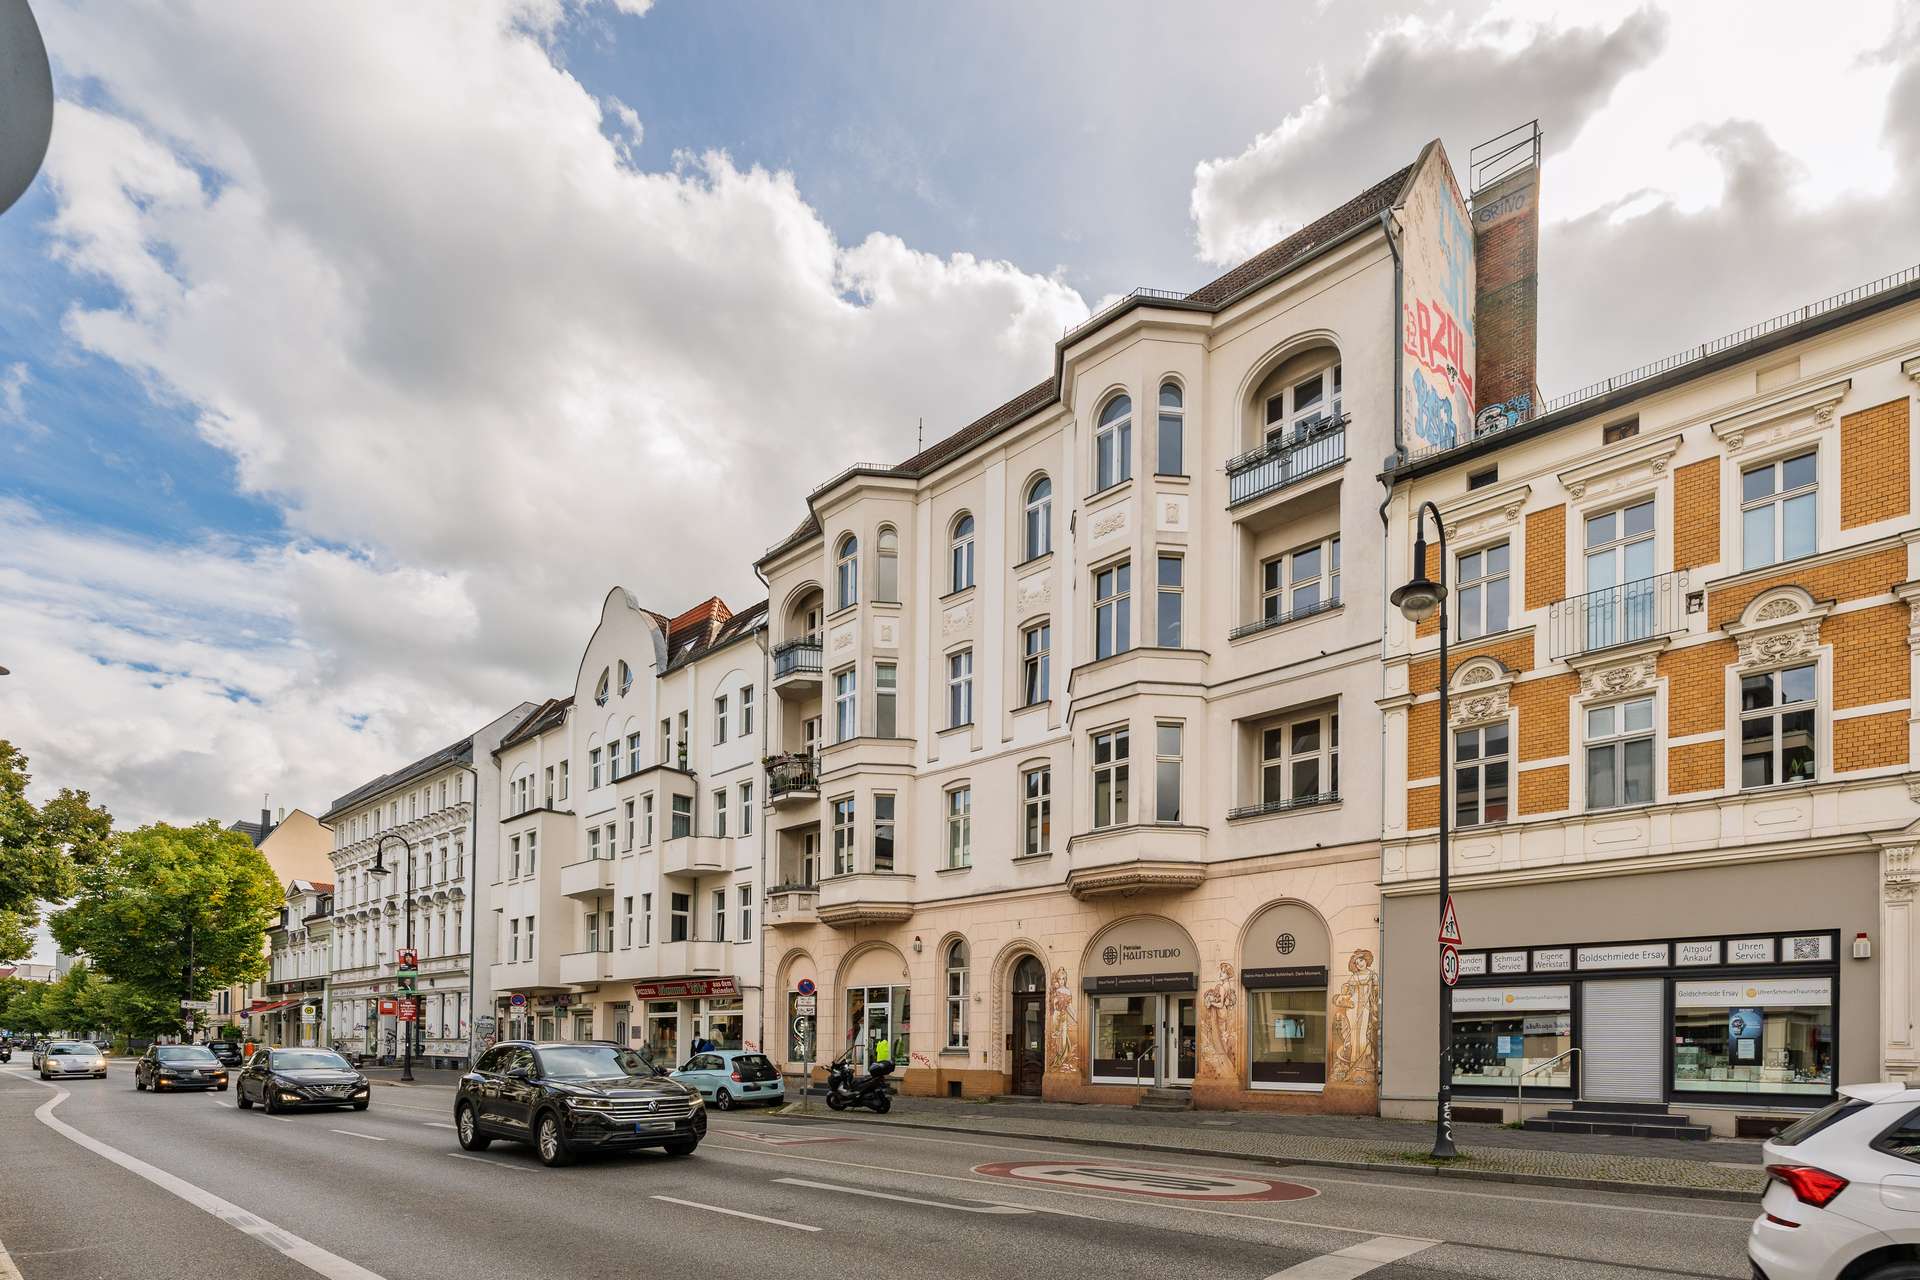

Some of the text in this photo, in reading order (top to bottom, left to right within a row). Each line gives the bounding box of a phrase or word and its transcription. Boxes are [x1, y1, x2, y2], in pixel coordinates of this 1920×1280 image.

[1682, 944, 1713, 954] Altgold
[1737, 942, 1764, 951] Uhren
[1123, 948, 1181, 961] HAUTSTUDIO
[1494, 952, 1524, 963] Schmuck
[1540, 952, 1564, 962] Eigene
[1578, 950, 1667, 963] Goldschmiede Ersay
[1682, 953, 1713, 962] Ankauf
[1735, 950, 1766, 961] Service
[1445, 955, 1456, 973] 30
[1497, 961, 1521, 971] Service
[1534, 960, 1569, 969] Werkstatt
